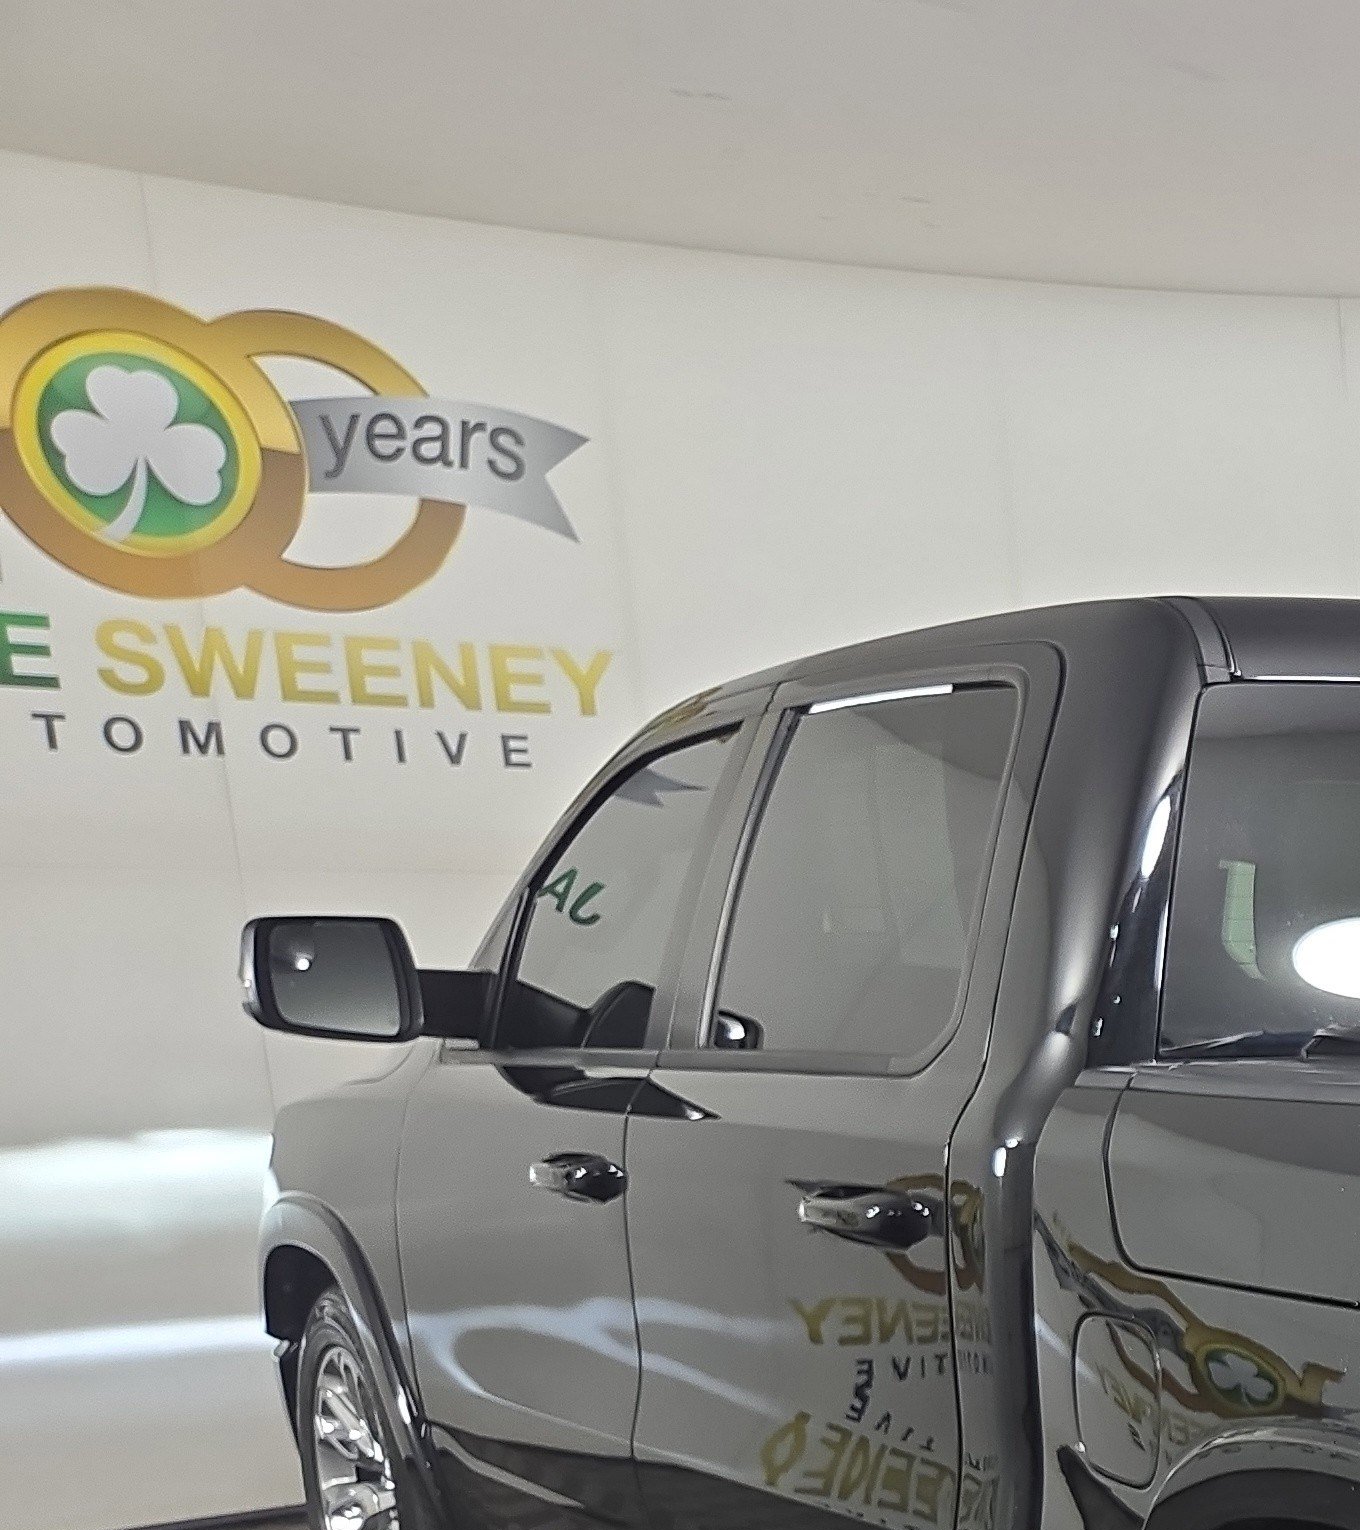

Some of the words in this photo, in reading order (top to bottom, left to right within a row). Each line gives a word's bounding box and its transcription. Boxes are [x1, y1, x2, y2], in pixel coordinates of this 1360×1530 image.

[318, 412, 527, 482] years
[94, 618, 614, 717] SWEENEY
[31, 712, 533, 768] TOMOTIVE
